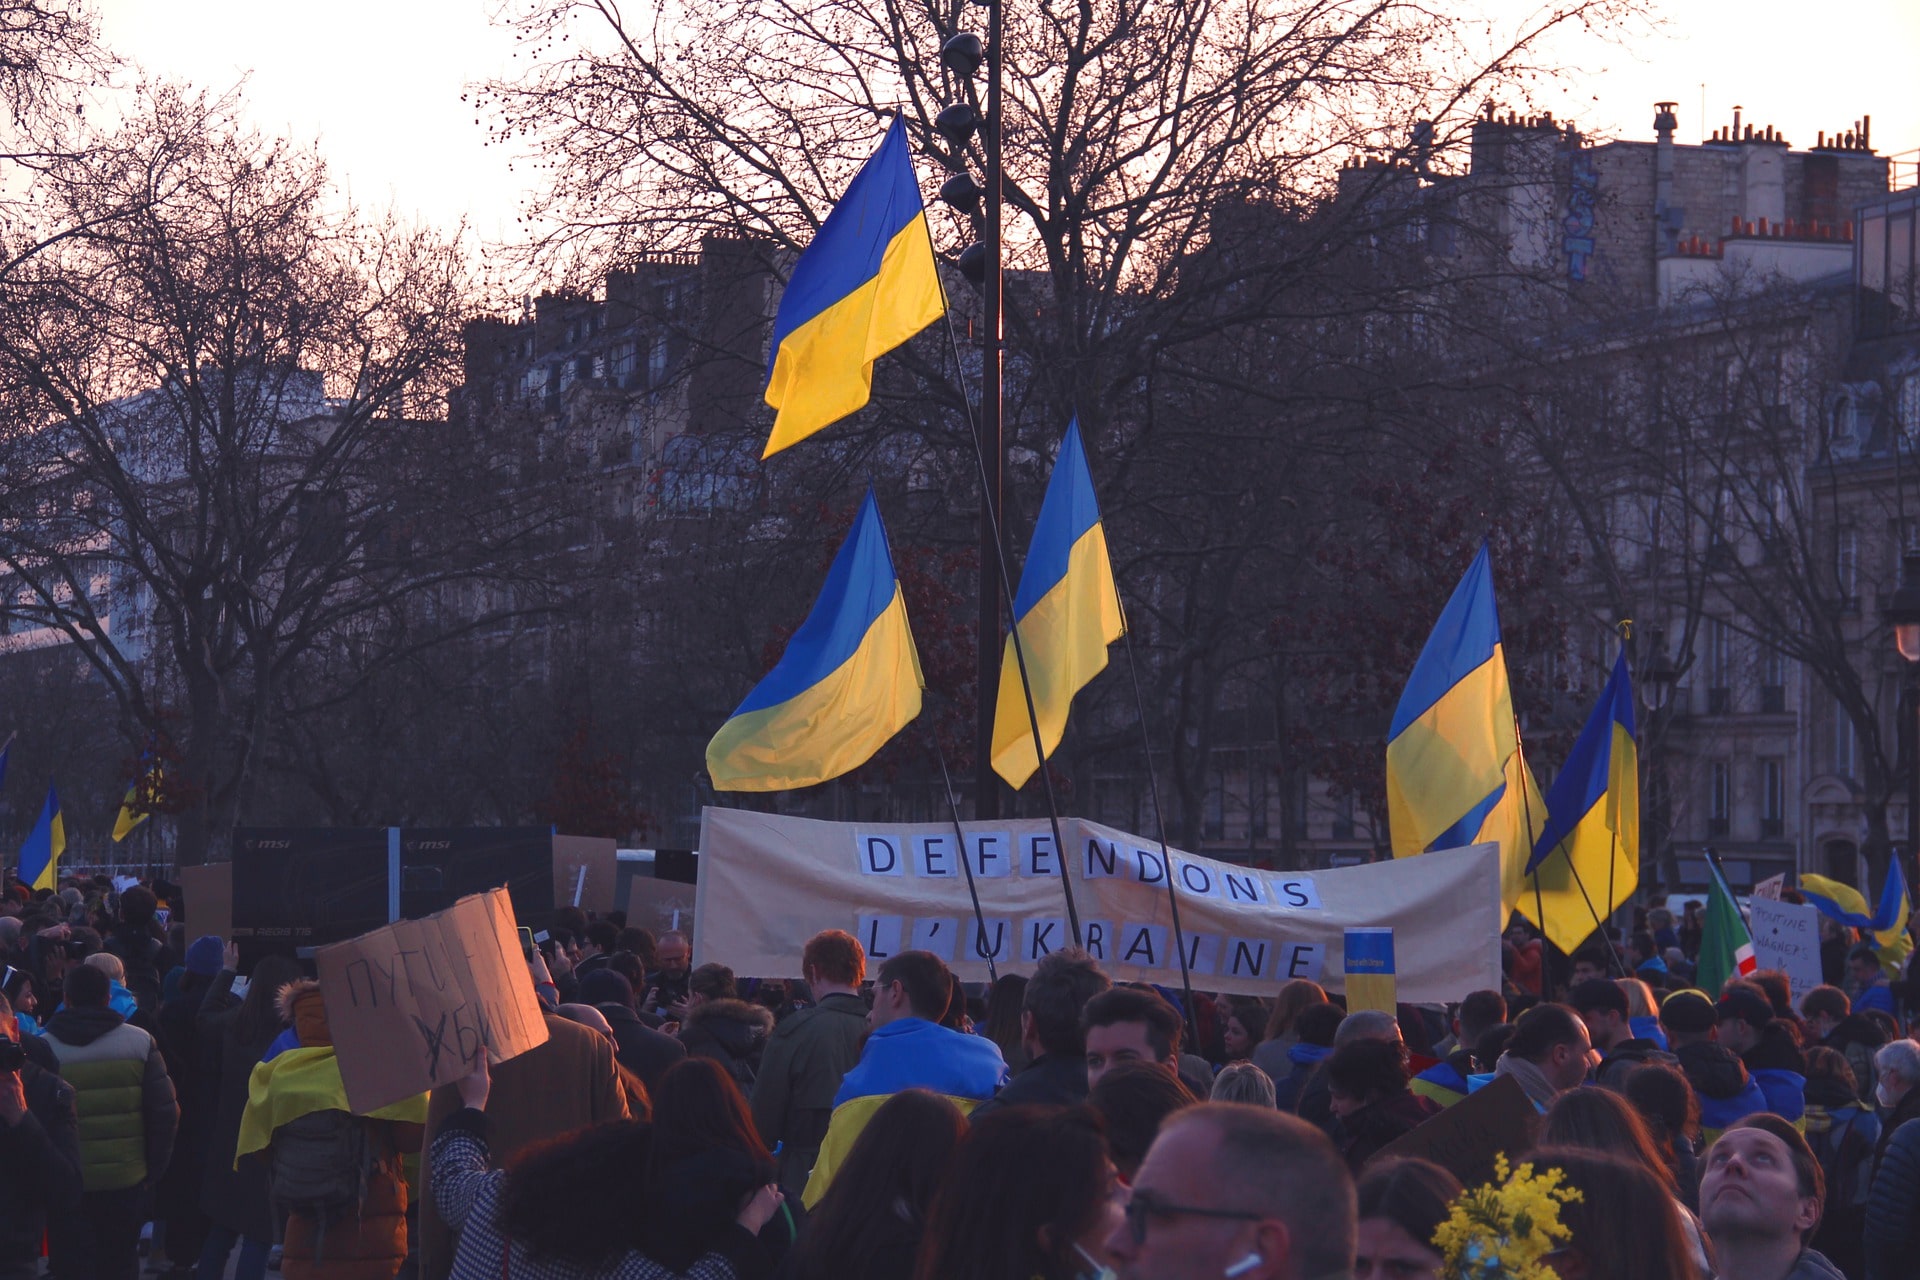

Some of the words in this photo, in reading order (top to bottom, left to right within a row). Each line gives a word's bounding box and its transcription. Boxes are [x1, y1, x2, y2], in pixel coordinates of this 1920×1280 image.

[257, 839, 291, 849] msi
[418, 840, 451, 850] msi
[868, 836, 1309, 907] DEFENDONS
[869, 918, 1314, 979] L'UKRAINE
